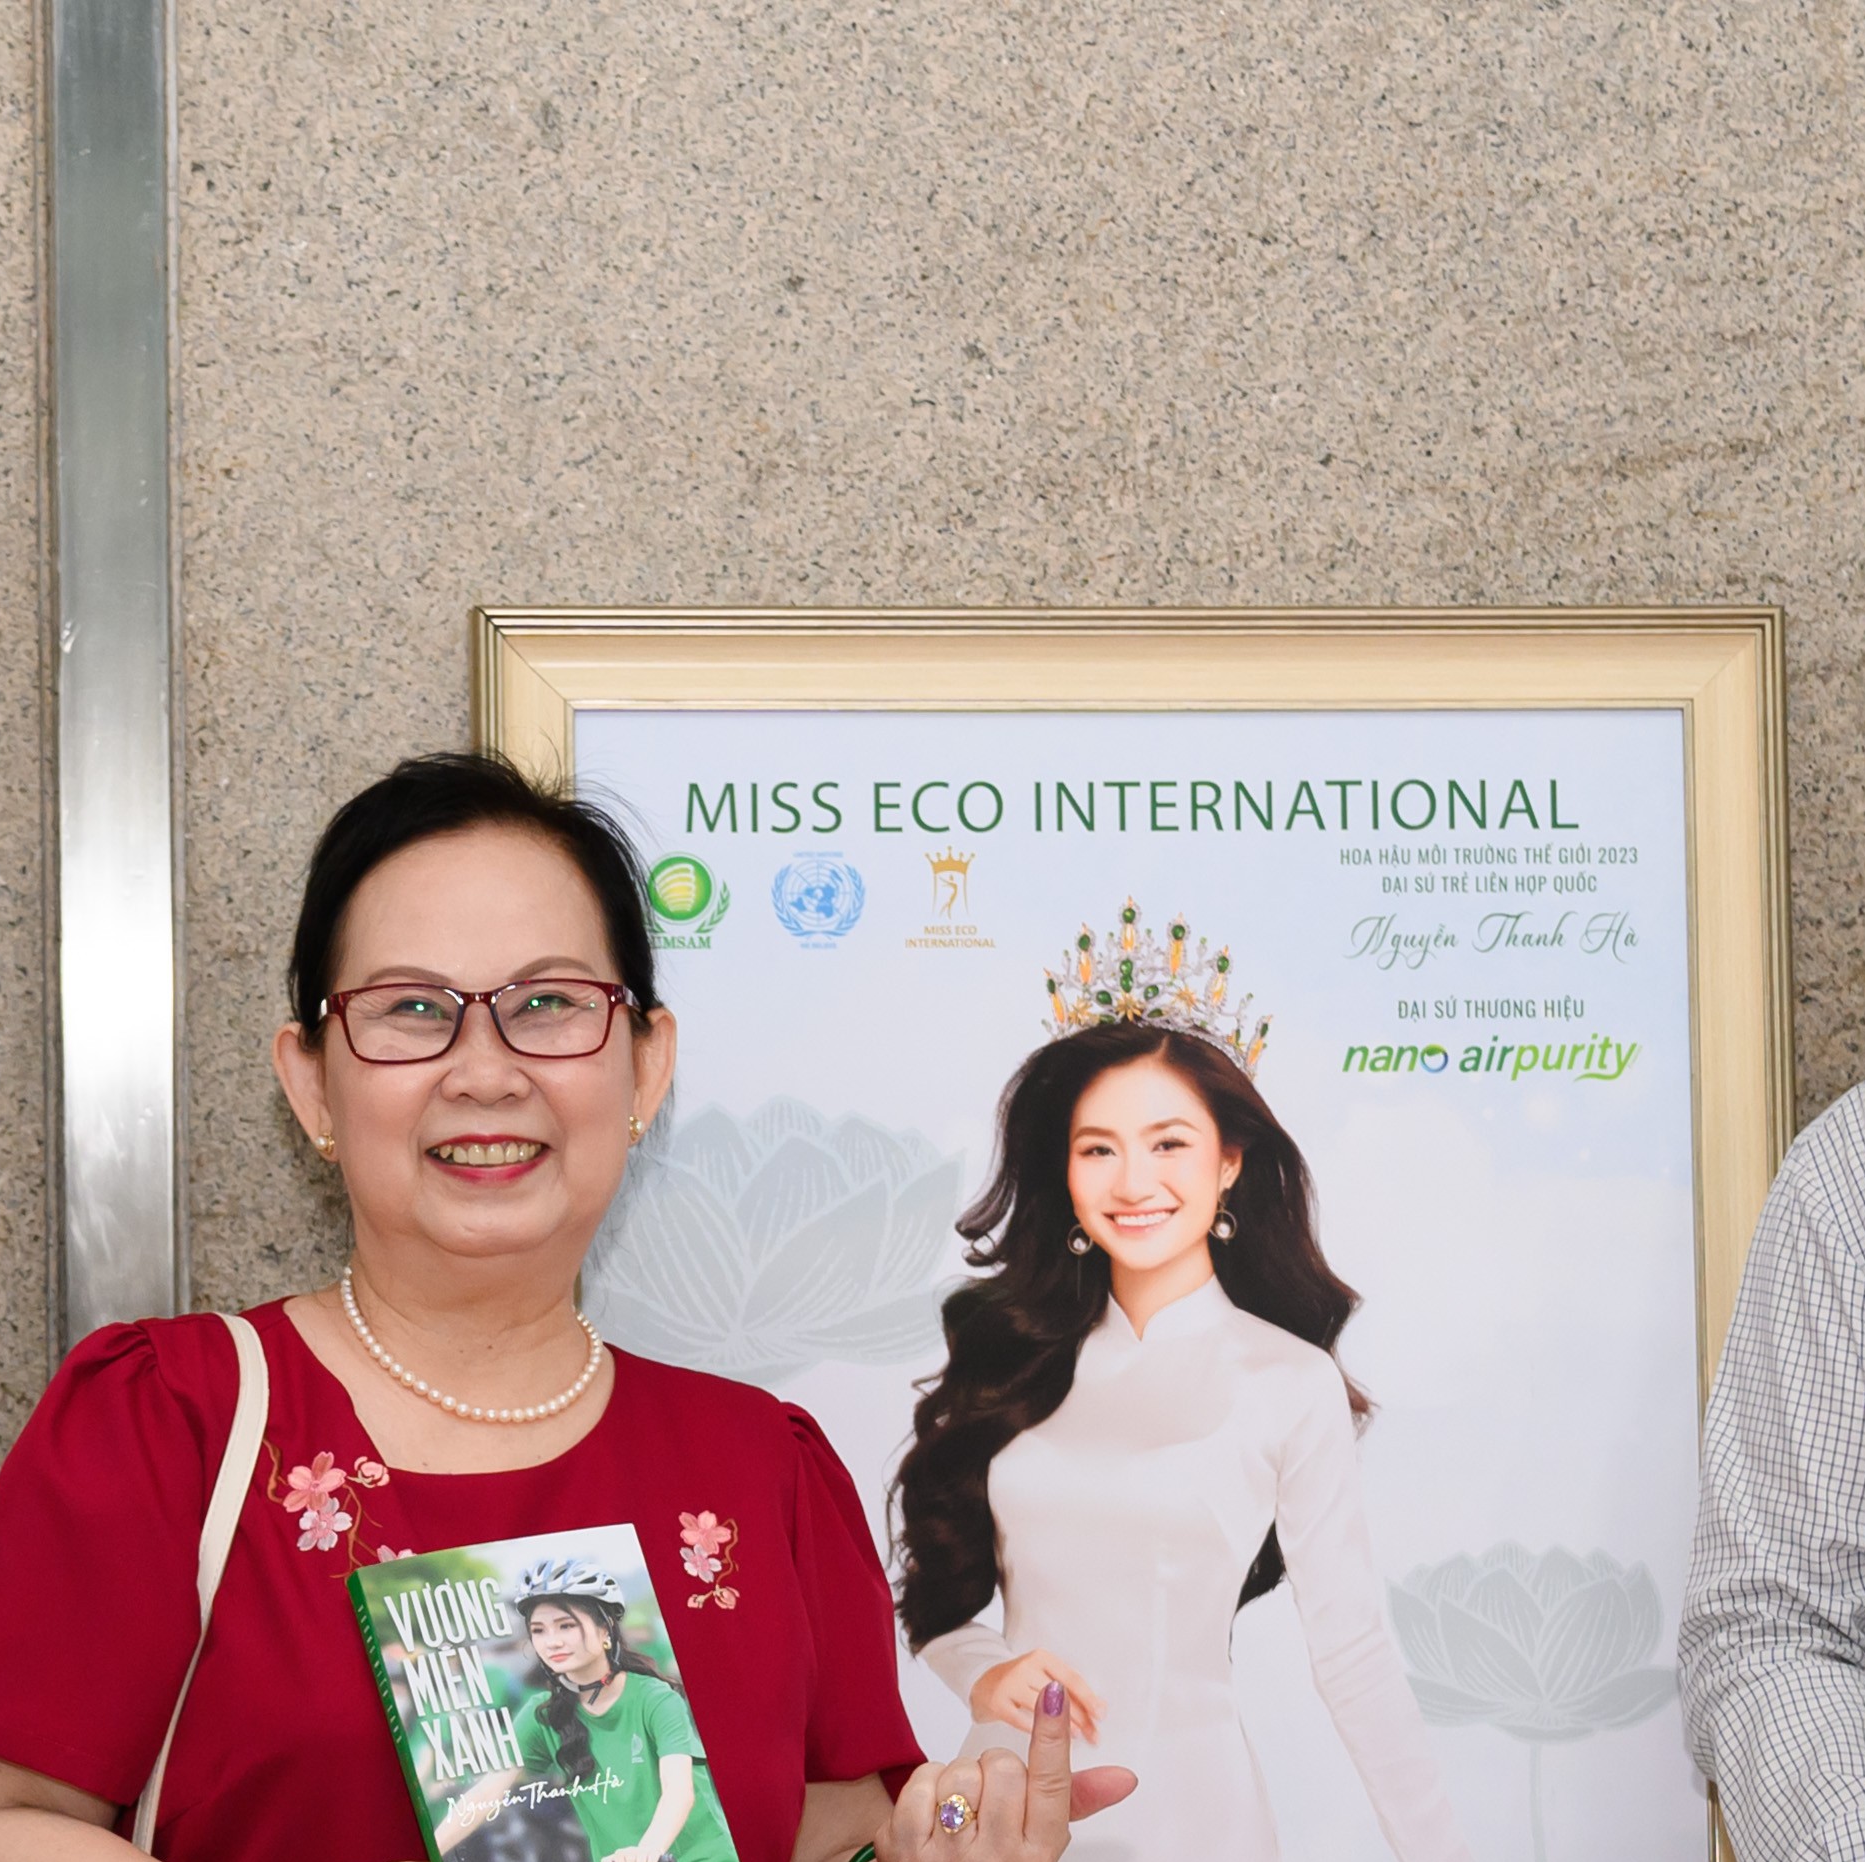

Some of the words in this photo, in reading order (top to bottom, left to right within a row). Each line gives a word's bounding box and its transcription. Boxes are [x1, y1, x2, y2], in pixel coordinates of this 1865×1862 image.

[685, 781, 843, 834] MISS
[873, 781, 1004, 834] ECO
[1034, 778, 1580, 833] INTERNATIONAL
[1339, 847, 1373, 865] HOA
[1379, 843, 1411, 869] HẬU
[1417, 843, 1447, 865] MÔI
[1454, 843, 1518, 865] TRƯỜNG
[1524, 842, 1554, 865] THẾ
[1558, 843, 1591, 865] GIỚI
[1597, 846, 1639, 864] 2023
[1381, 875, 1408, 897] ĐẠI
[1414, 871, 1436, 893] SỨ
[1442, 871, 1469, 893] TRẺ
[1475, 871, 1508, 893] LIÊN
[1515, 873, 1547, 895] HỢP
[1553, 870, 1597, 893] QUỐC
[905, 938, 996, 948] INTERNATIONAL
[923, 925, 952, 935] MISS
[955, 925, 977, 935] ECO
[1342, 912, 1460, 970] Nguyễn
[1472, 910, 1579, 953] Thanh
[1578, 910, 1641, 964] Hà
[1398, 1000, 1426, 1023] ĐẠI
[1434, 995, 1458, 1019] SỨ
[1463, 998, 1536, 1019] THƯƠNG
[1544, 994, 1585, 1022] HIỆU
[1341, 1043, 1449, 1074] nano
[1458, 1033, 1639, 1082] airpurity
[383, 1575, 513, 1655] VƯƠNG
[401, 1642, 495, 1717] MIỆN
[420, 1705, 525, 1781] XANH
[519, 1774, 586, 1810] Thanh
[583, 1766, 625, 1804] Hà
